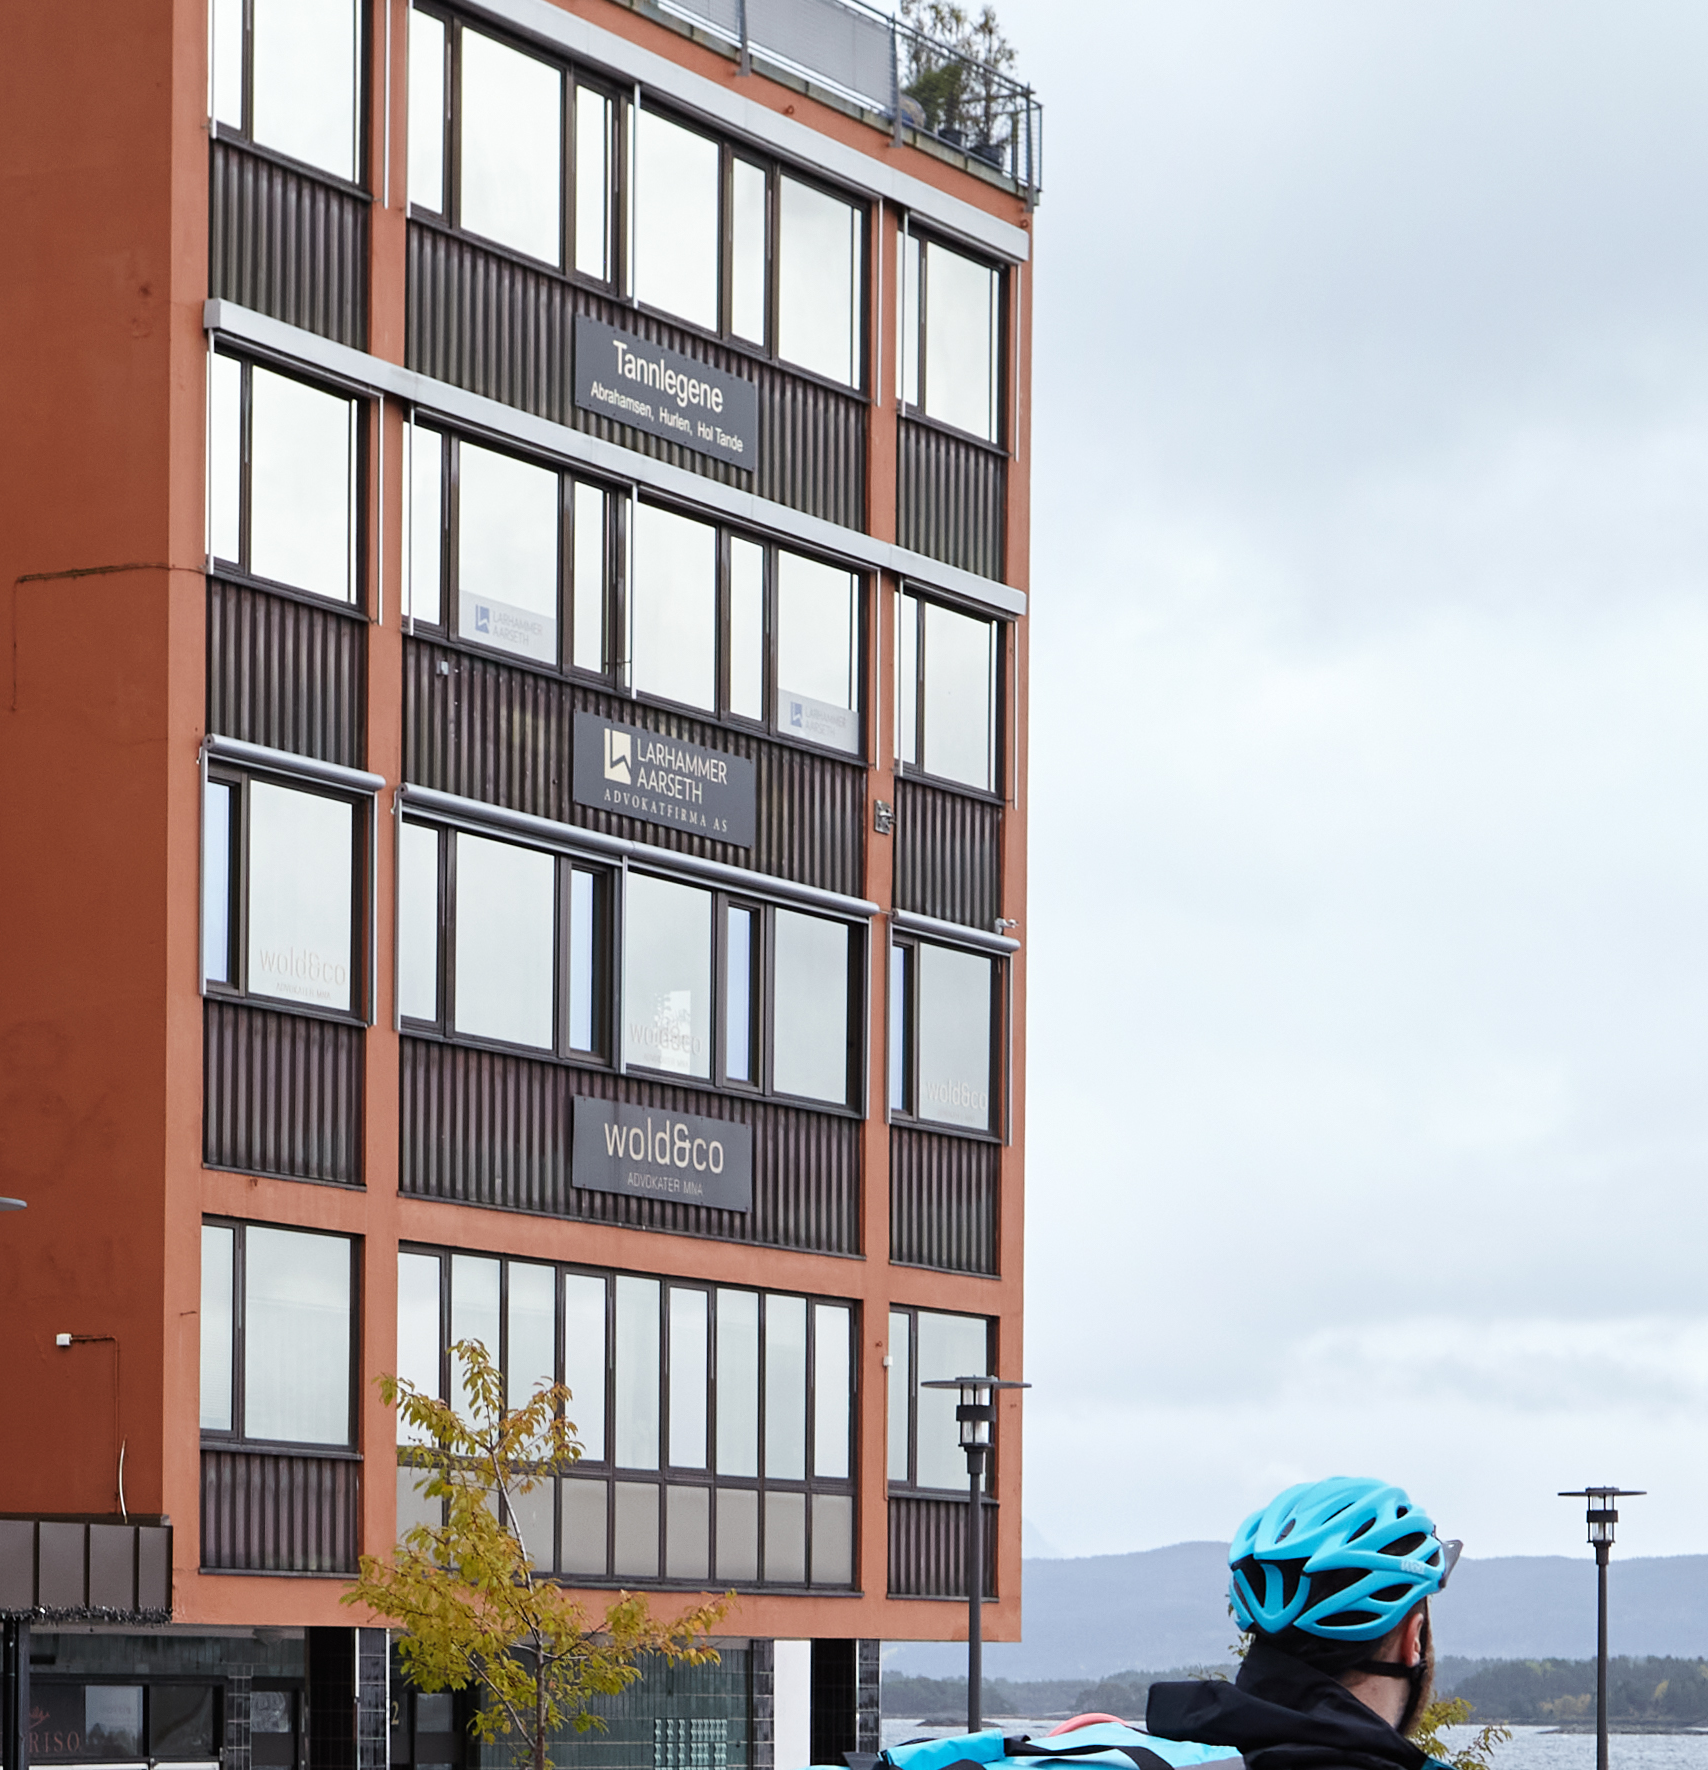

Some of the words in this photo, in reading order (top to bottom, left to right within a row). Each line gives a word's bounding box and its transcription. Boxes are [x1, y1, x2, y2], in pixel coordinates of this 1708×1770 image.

[612, 339, 724, 413] Tannlegene
[590, 380, 655, 422] Abrahamsen,
[659, 406, 693, 436] Hurlen,
[697, 420, 714, 442] Hol
[715, 427, 744, 452] Tande
[637, 737, 728, 785] LARHAMMER
[604, 788, 707, 827] ADVOKATFIRMA
[713, 818, 728, 832] AS
[637, 767, 703, 805] AARSETH
[604, 1117, 724, 1174] wold&co
[627, 1172, 680, 1193] ADVOKATER
[683, 1181, 704, 1195] MNA
